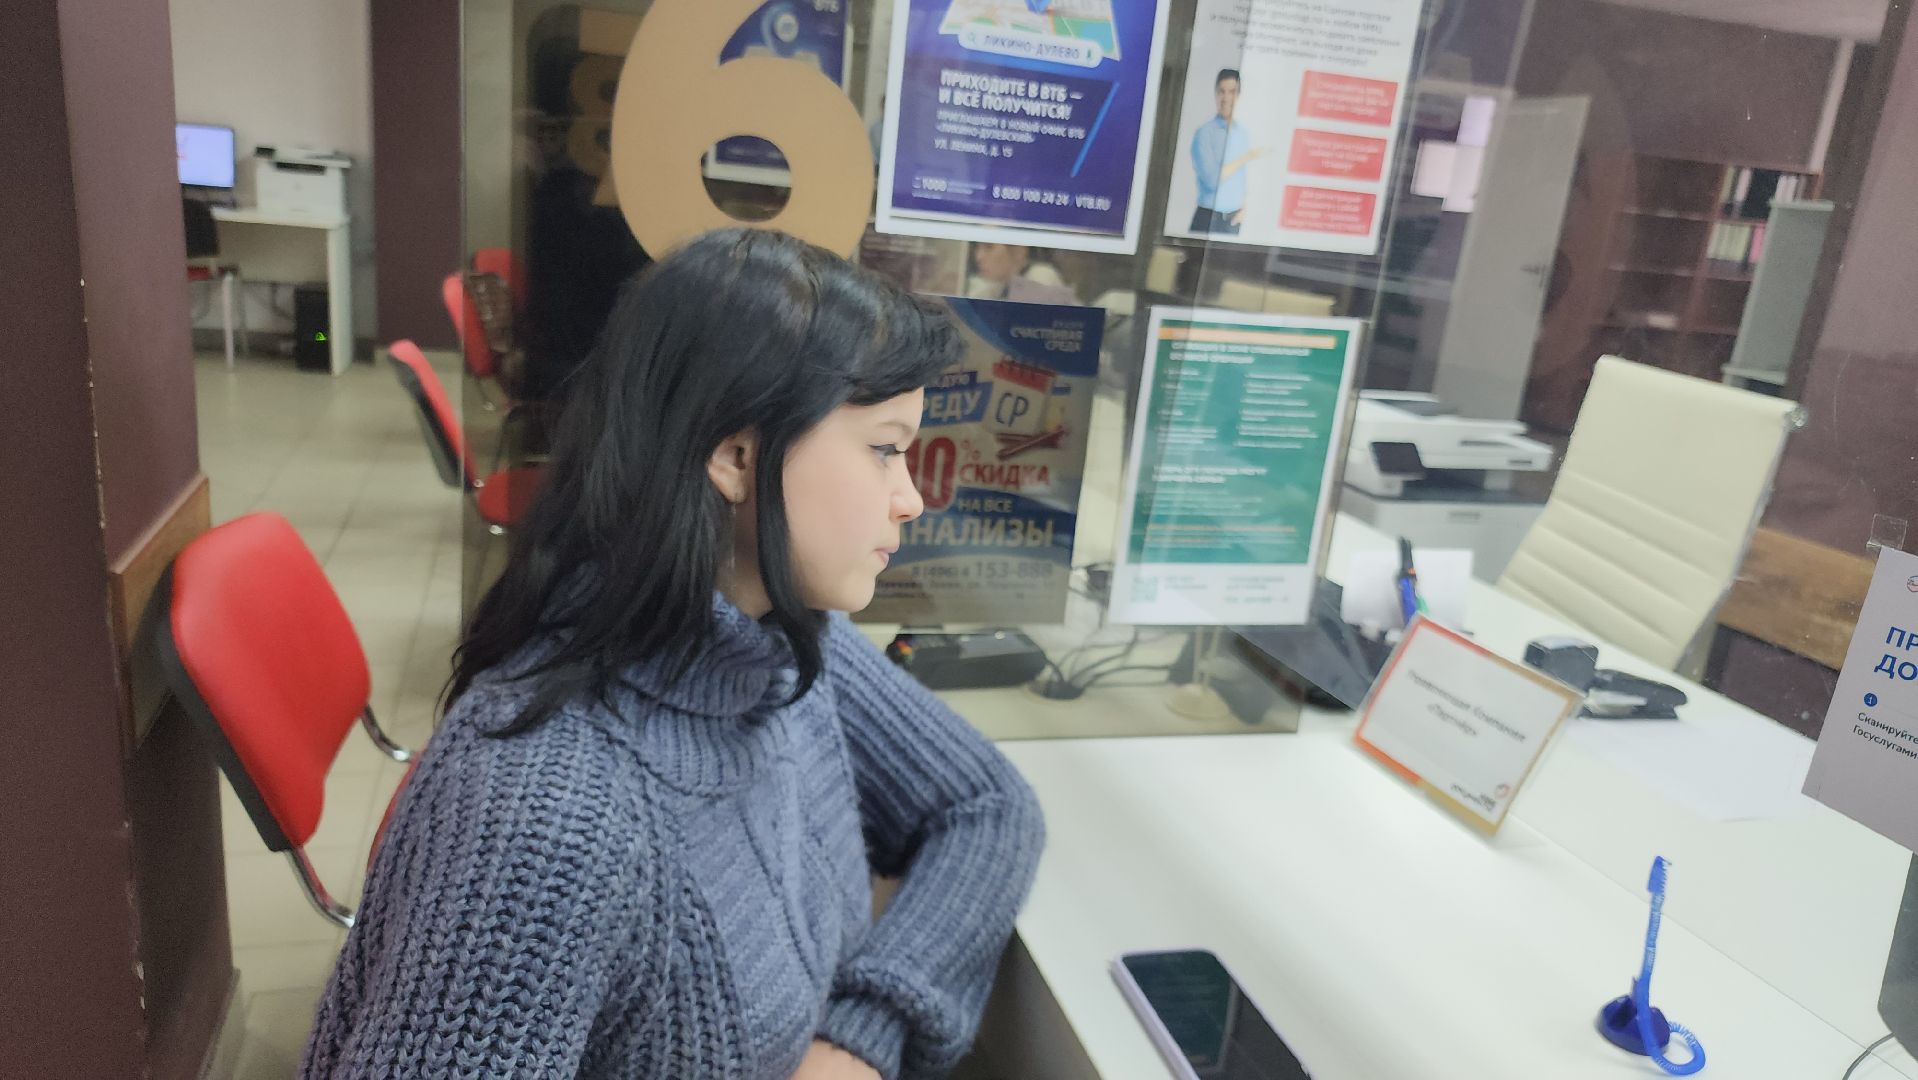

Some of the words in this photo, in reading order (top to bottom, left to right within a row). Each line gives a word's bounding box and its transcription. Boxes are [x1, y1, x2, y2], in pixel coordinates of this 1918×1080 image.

[940, 69, 1026, 96] ПРИХОДИТЕ
[1028, 81, 1039, 98] В
[1040, 83, 1068, 102] ВТБ
[938, 87, 951, 104] И
[982, 96, 1073, 120] ПОЛУЧИТСЯ!
[611, 0, 874, 263] 6
[1041, 190, 1055, 205] 24
[1055, 191, 1069, 207] 24
[959, 462, 1050, 490] СКИДКА
[958, 497, 980, 513] НА
[983, 498, 1013, 514] ВСЕ
[1853, 724, 1918, 760] Госуслугами
[1857, 711, 1918, 745] Сканируйте
